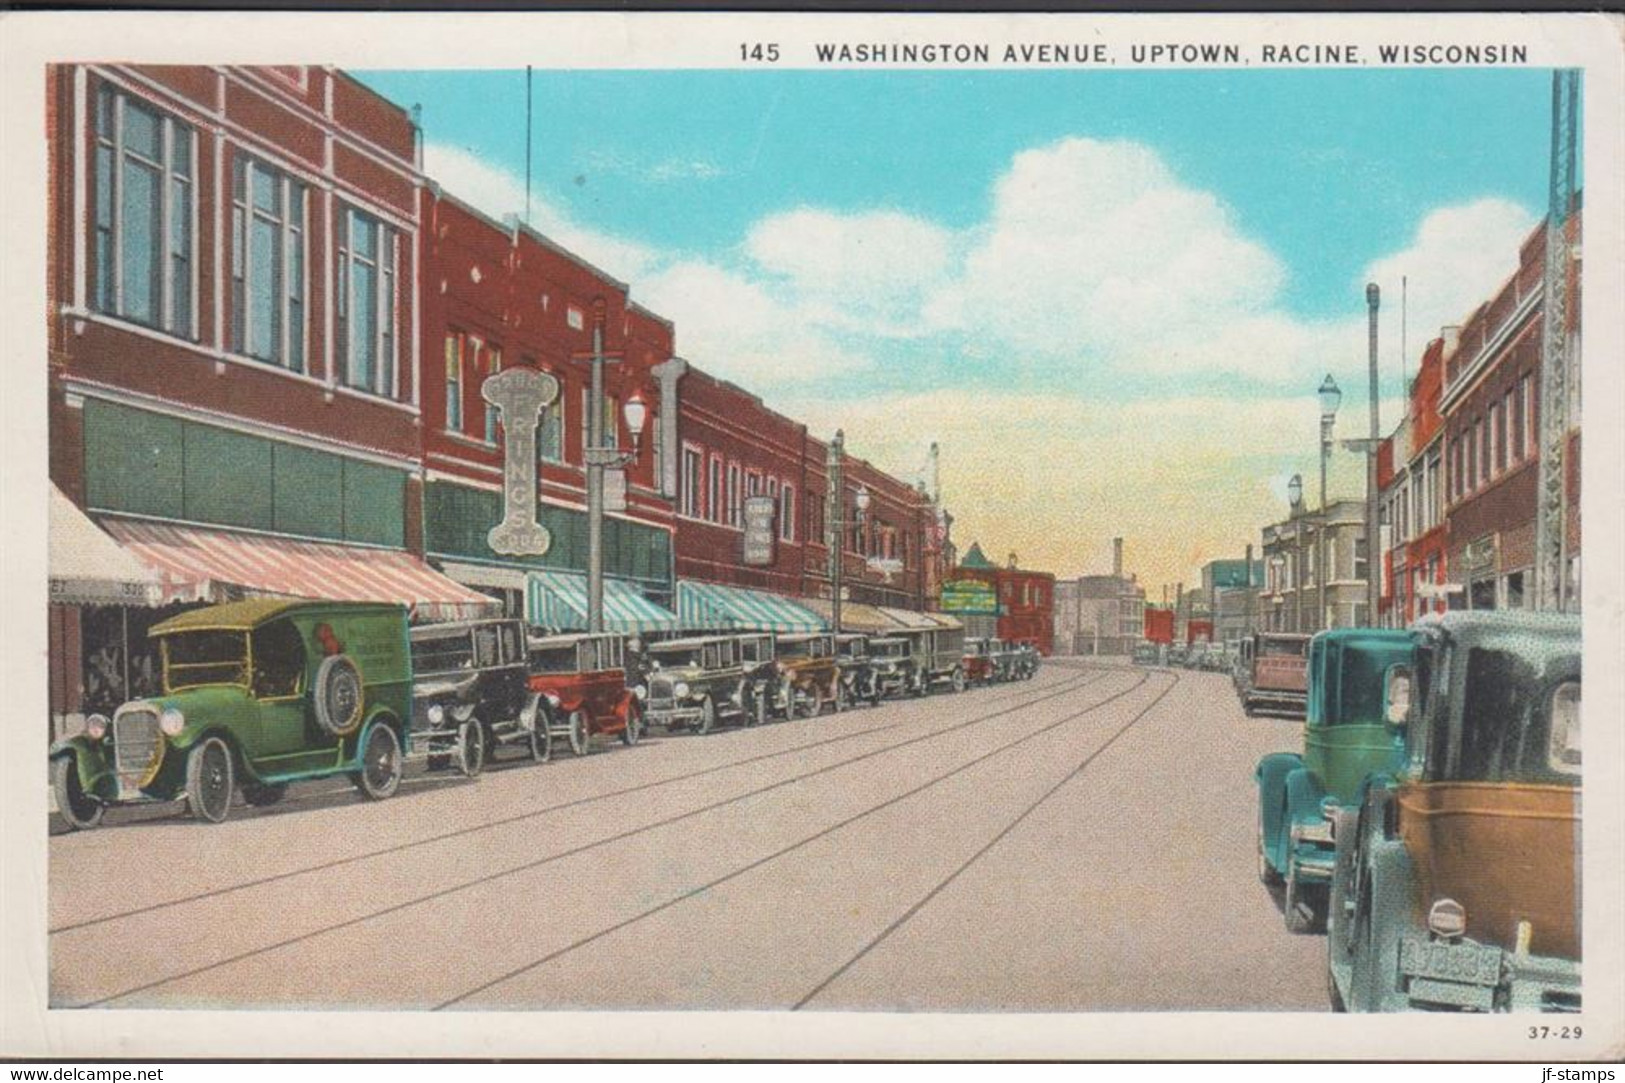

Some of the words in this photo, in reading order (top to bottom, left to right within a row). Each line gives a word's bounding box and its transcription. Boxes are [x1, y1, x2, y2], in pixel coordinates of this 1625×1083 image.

[740, 44, 780, 62] 145
[816, 44, 988, 62] WASHINGTON
[1003, 44, 1116, 65] AVENUE,
[1132, 44, 1249, 65] UPTOWN,
[1379, 44, 1528, 63] WISCONSIN
[1528, 1026, 1583, 1040] 37-29
